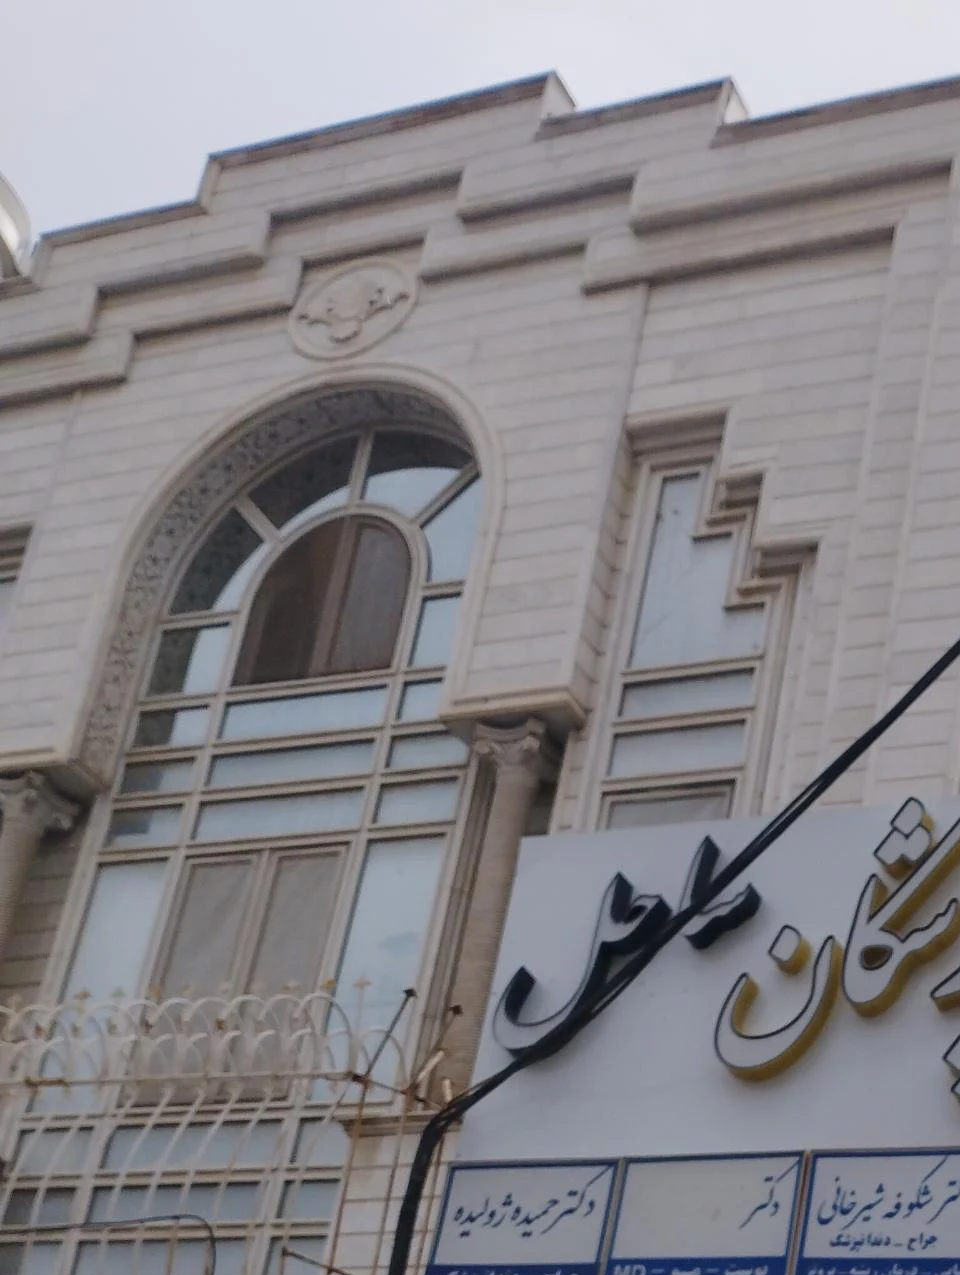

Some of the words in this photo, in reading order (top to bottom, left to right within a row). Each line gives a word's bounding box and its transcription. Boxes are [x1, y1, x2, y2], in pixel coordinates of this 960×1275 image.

[493, 835, 762, 1057] ساحل
[540, 1165, 611, 1235] دکتر
[738, 1159, 800, 1230] دکتر
[882, 1155, 949, 1219] شکوفه
[829, 1233, 891, 1251] دندانپزشک
[907, 1232, 938, 1250] جراح
